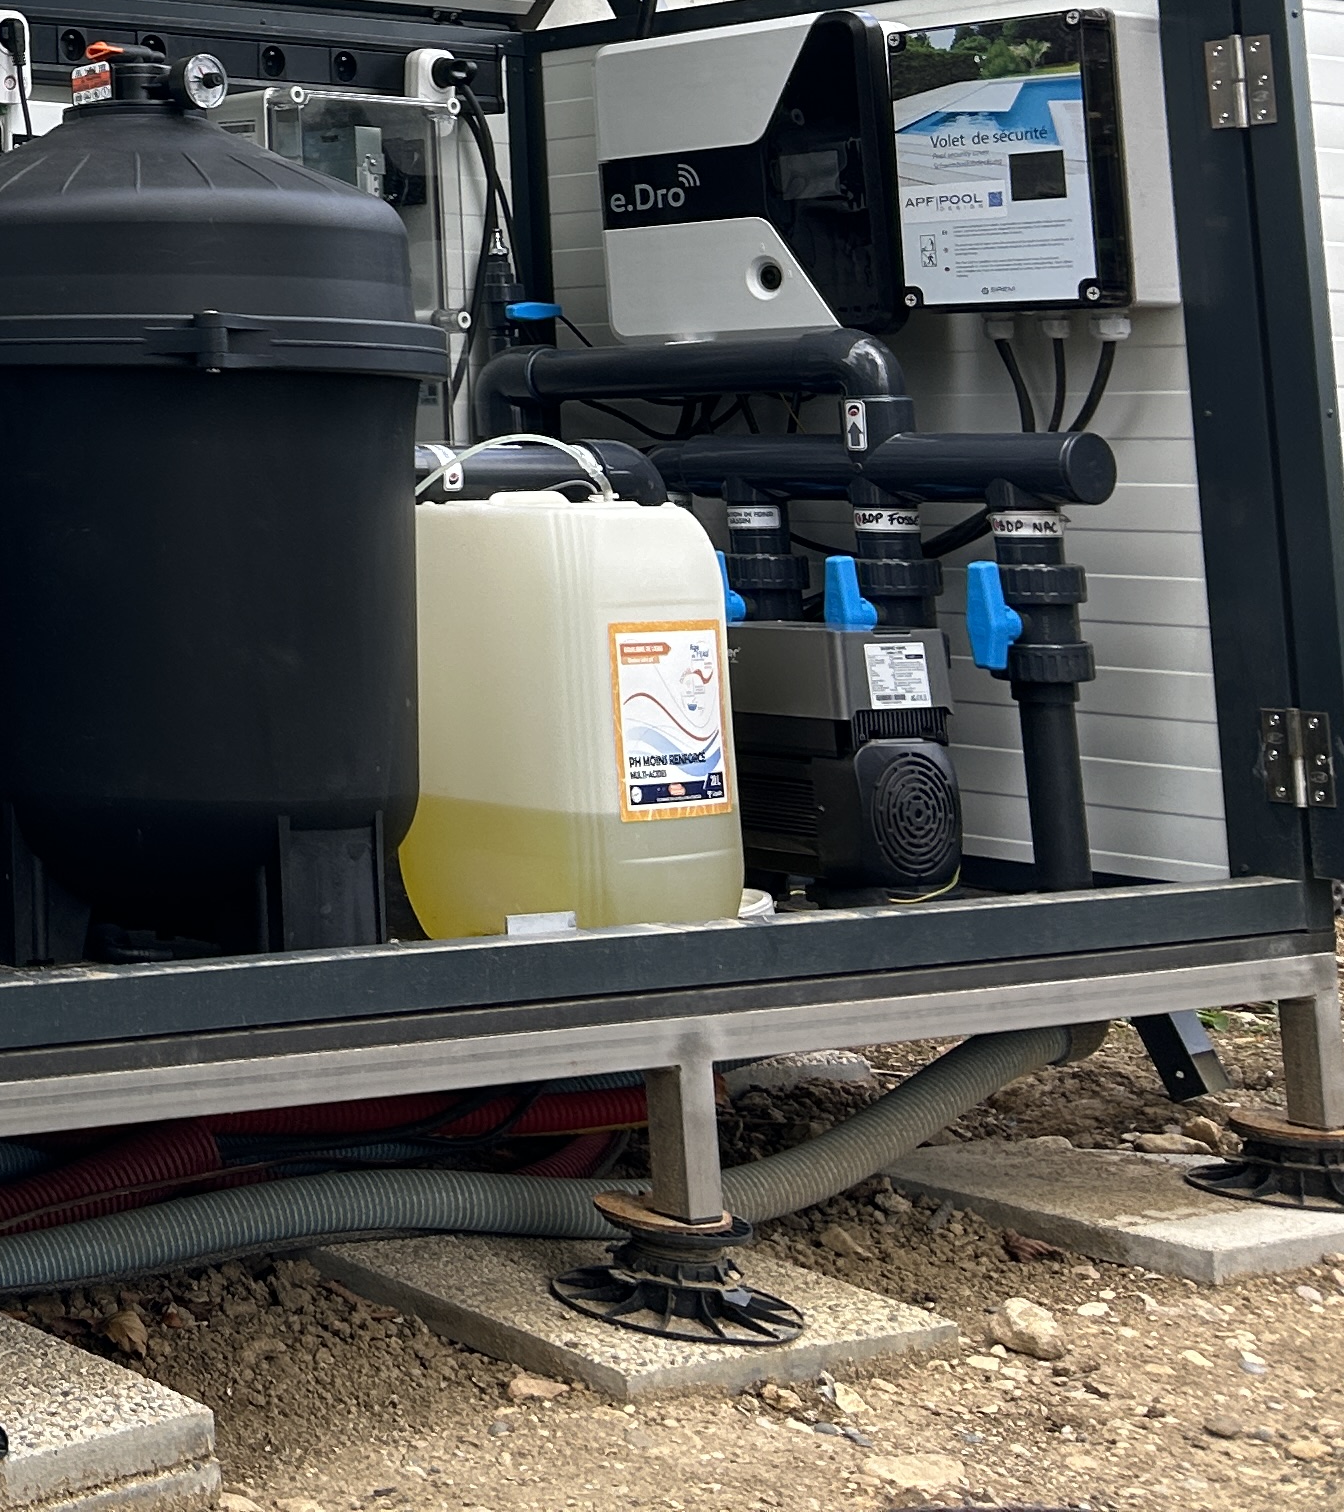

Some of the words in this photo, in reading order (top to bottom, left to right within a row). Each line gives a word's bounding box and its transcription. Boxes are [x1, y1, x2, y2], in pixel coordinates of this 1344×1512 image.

[929, 134, 966, 149] Volet
[971, 131, 990, 145] de
[992, 125, 1048, 144] sécurité
[609, 183, 686, 213] e.Dro
[905, 196, 936, 208] APF
[939, 193, 984, 206] POOL
[643, 755, 668, 767] MOINS
